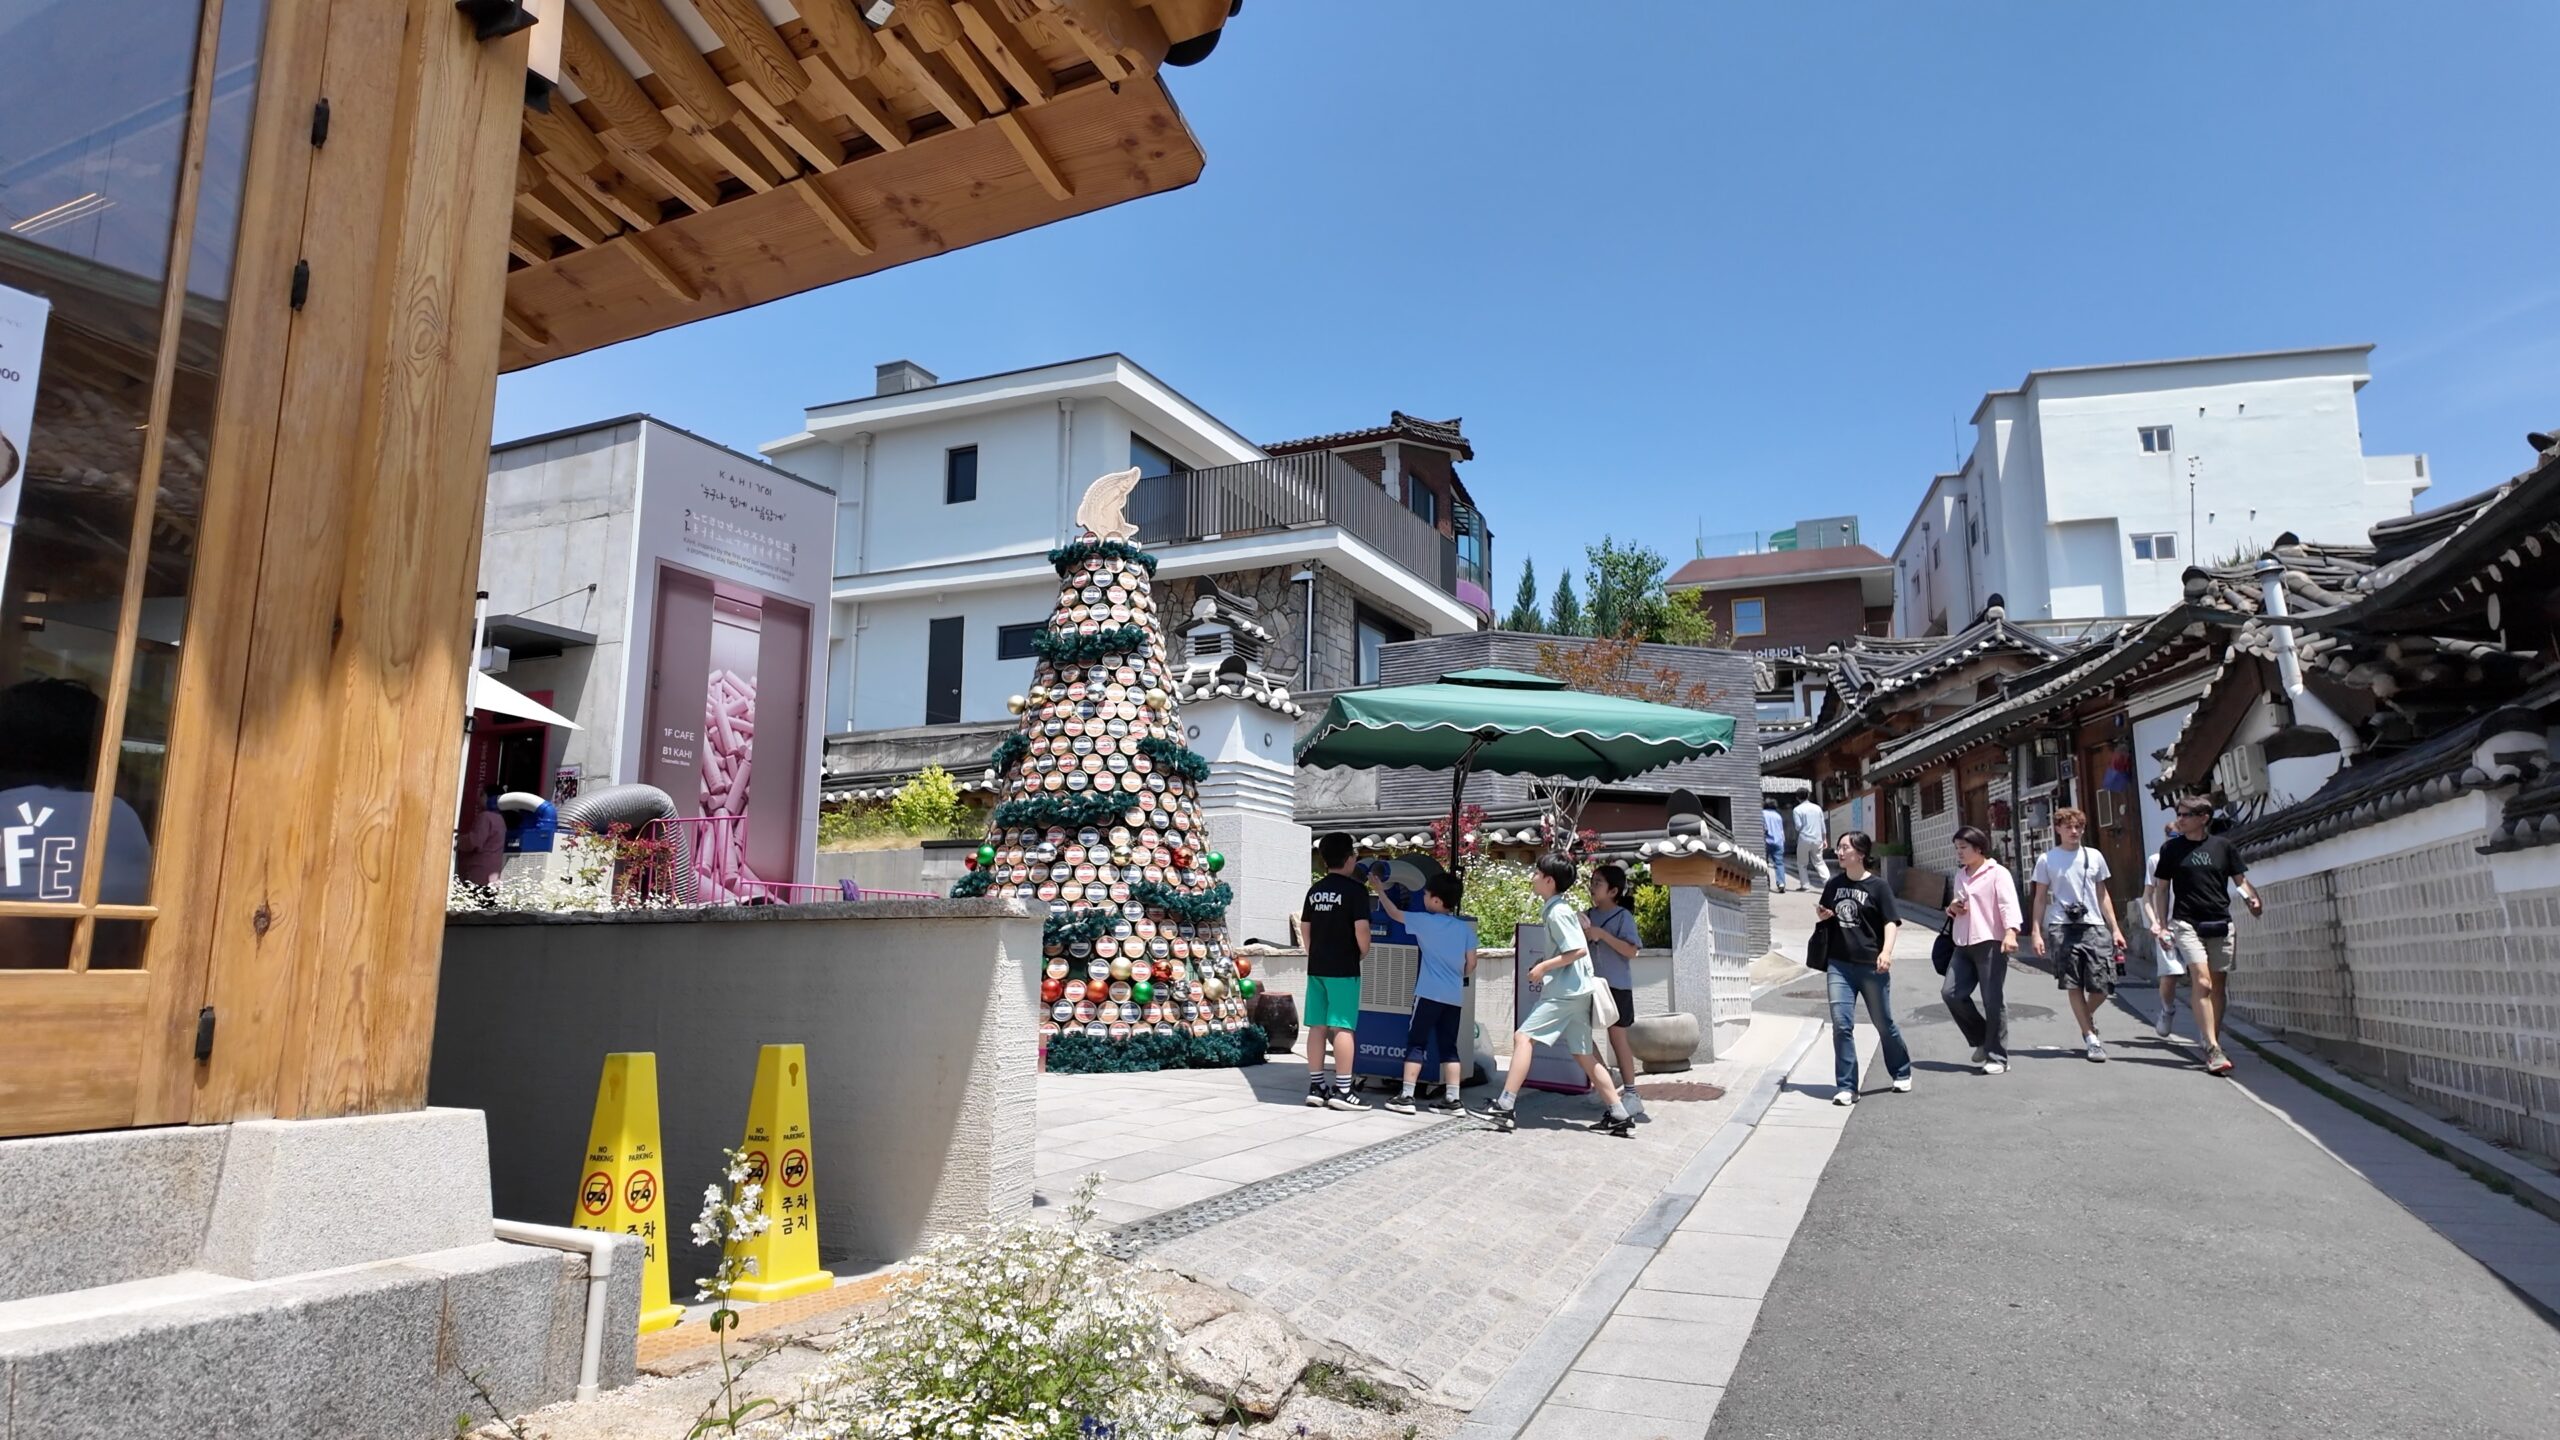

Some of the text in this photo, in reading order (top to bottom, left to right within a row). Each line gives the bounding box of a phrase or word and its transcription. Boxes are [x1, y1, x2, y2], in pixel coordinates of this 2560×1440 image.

[719, 470, 752, 489] KAHI
[664, 727, 695, 741] 1F CAFE
[662, 746, 693, 759] B1 KAHI
[1309, 891, 1342, 906] KOREA
[1314, 903, 1333, 912] ARMY
[1359, 1043, 1387, 1056] SPOT
[783, 1132, 805, 1141] PARKING
[598, 1145, 608, 1153] NO
[636, 1144, 646, 1152] NO
[589, 1153, 614, 1163] PARKING
[628, 1152, 654, 1161] PARKING
[781, 1193, 808, 1213] 주차
[782, 1214, 808, 1235] 금지
